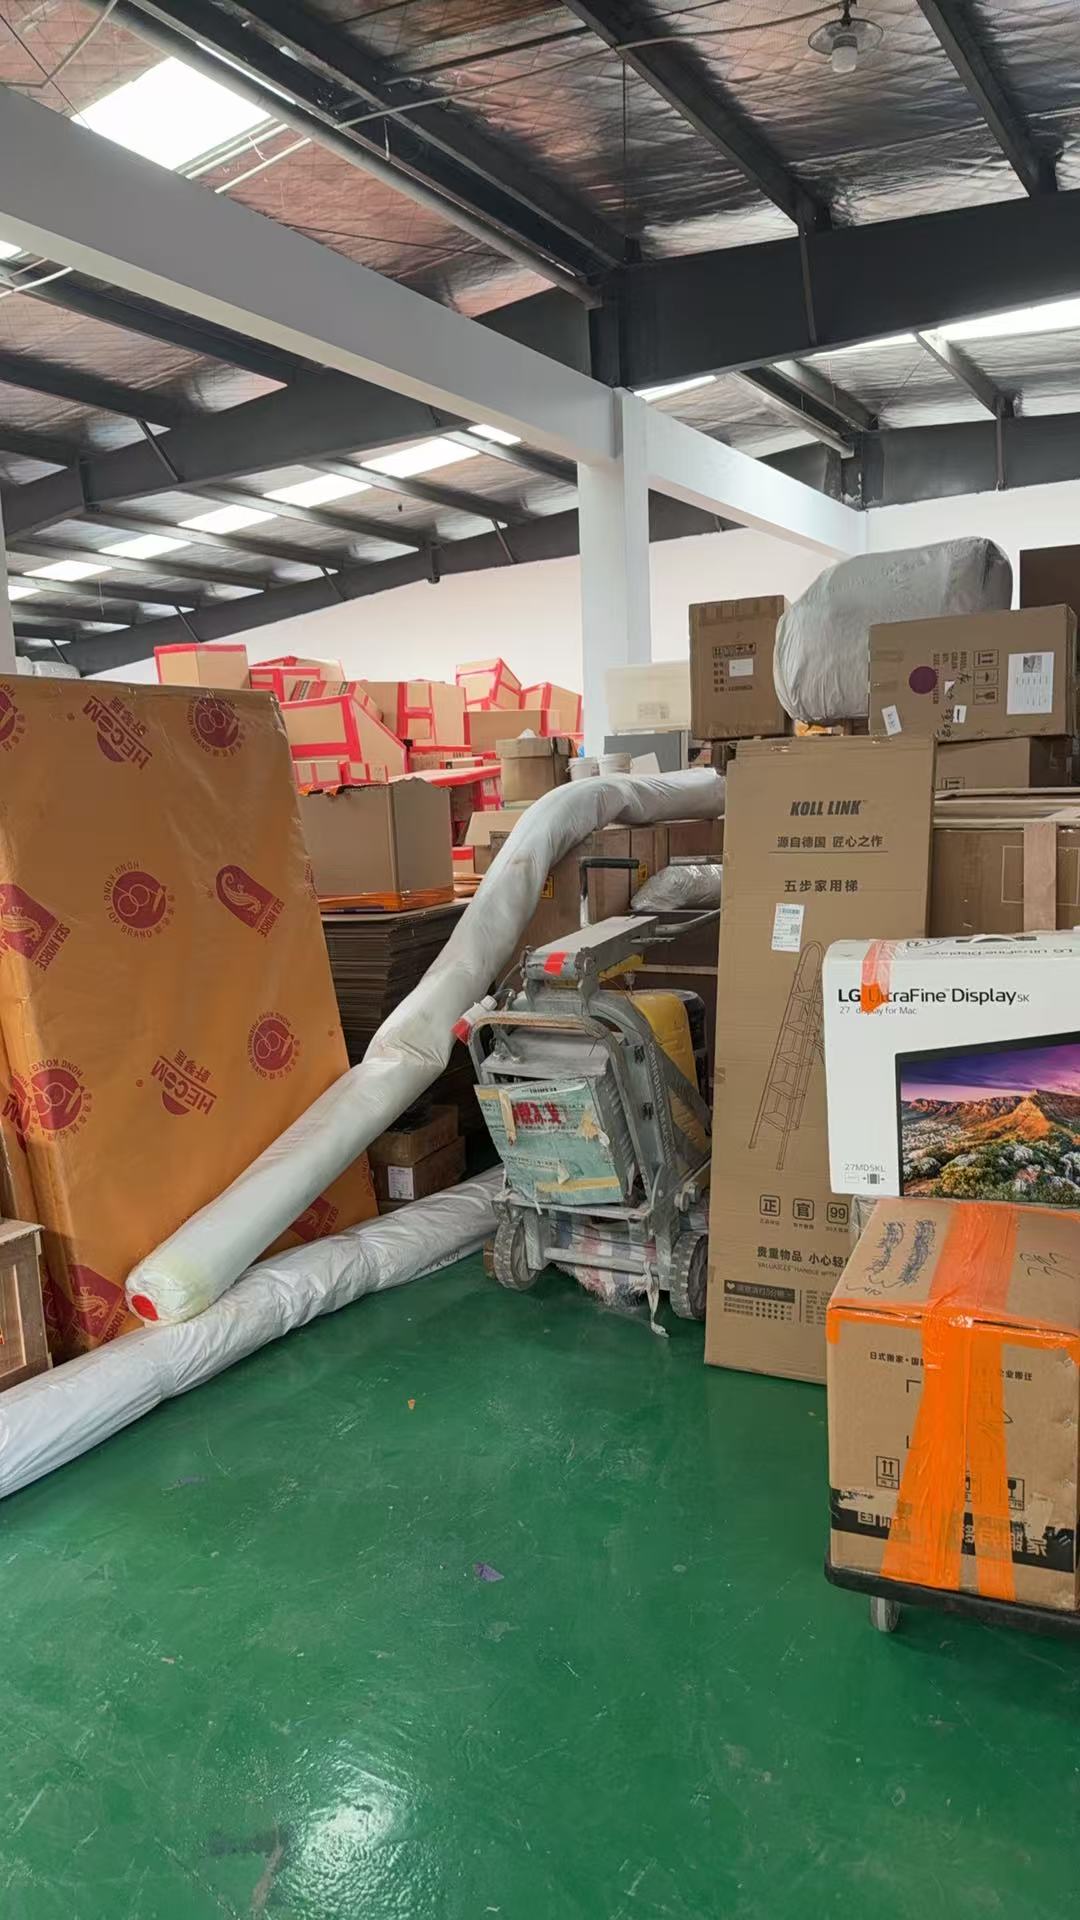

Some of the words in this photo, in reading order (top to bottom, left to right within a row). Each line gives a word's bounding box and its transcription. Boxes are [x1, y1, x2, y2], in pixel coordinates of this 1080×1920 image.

[83, 700, 150, 770] HECOM
[790, 800, 824, 816] KOLL
[827, 799, 862, 815] LINK
[777, 836, 826, 848] 源自德国
[832, 835, 883, 848] 匠心之作
[784, 879, 858, 893] 五步家用梯
[52, 922, 71, 944] SEA
[35, 939, 61, 972] HORSE
[838, 988, 861, 1003] LG
[951, 988, 1017, 1006] Display
[885, 1006, 898, 1015] for
[900, 1006, 918, 1015] Mac
[61, 1060, 84, 1078] HONG
[151, 1060, 215, 1115] HECOM
[762, 1198, 777, 1213] 正
[796, 1203, 811, 1218] 官
[829, 1207, 846, 1220] 99
[757, 1246, 803, 1263] 贵重物品
